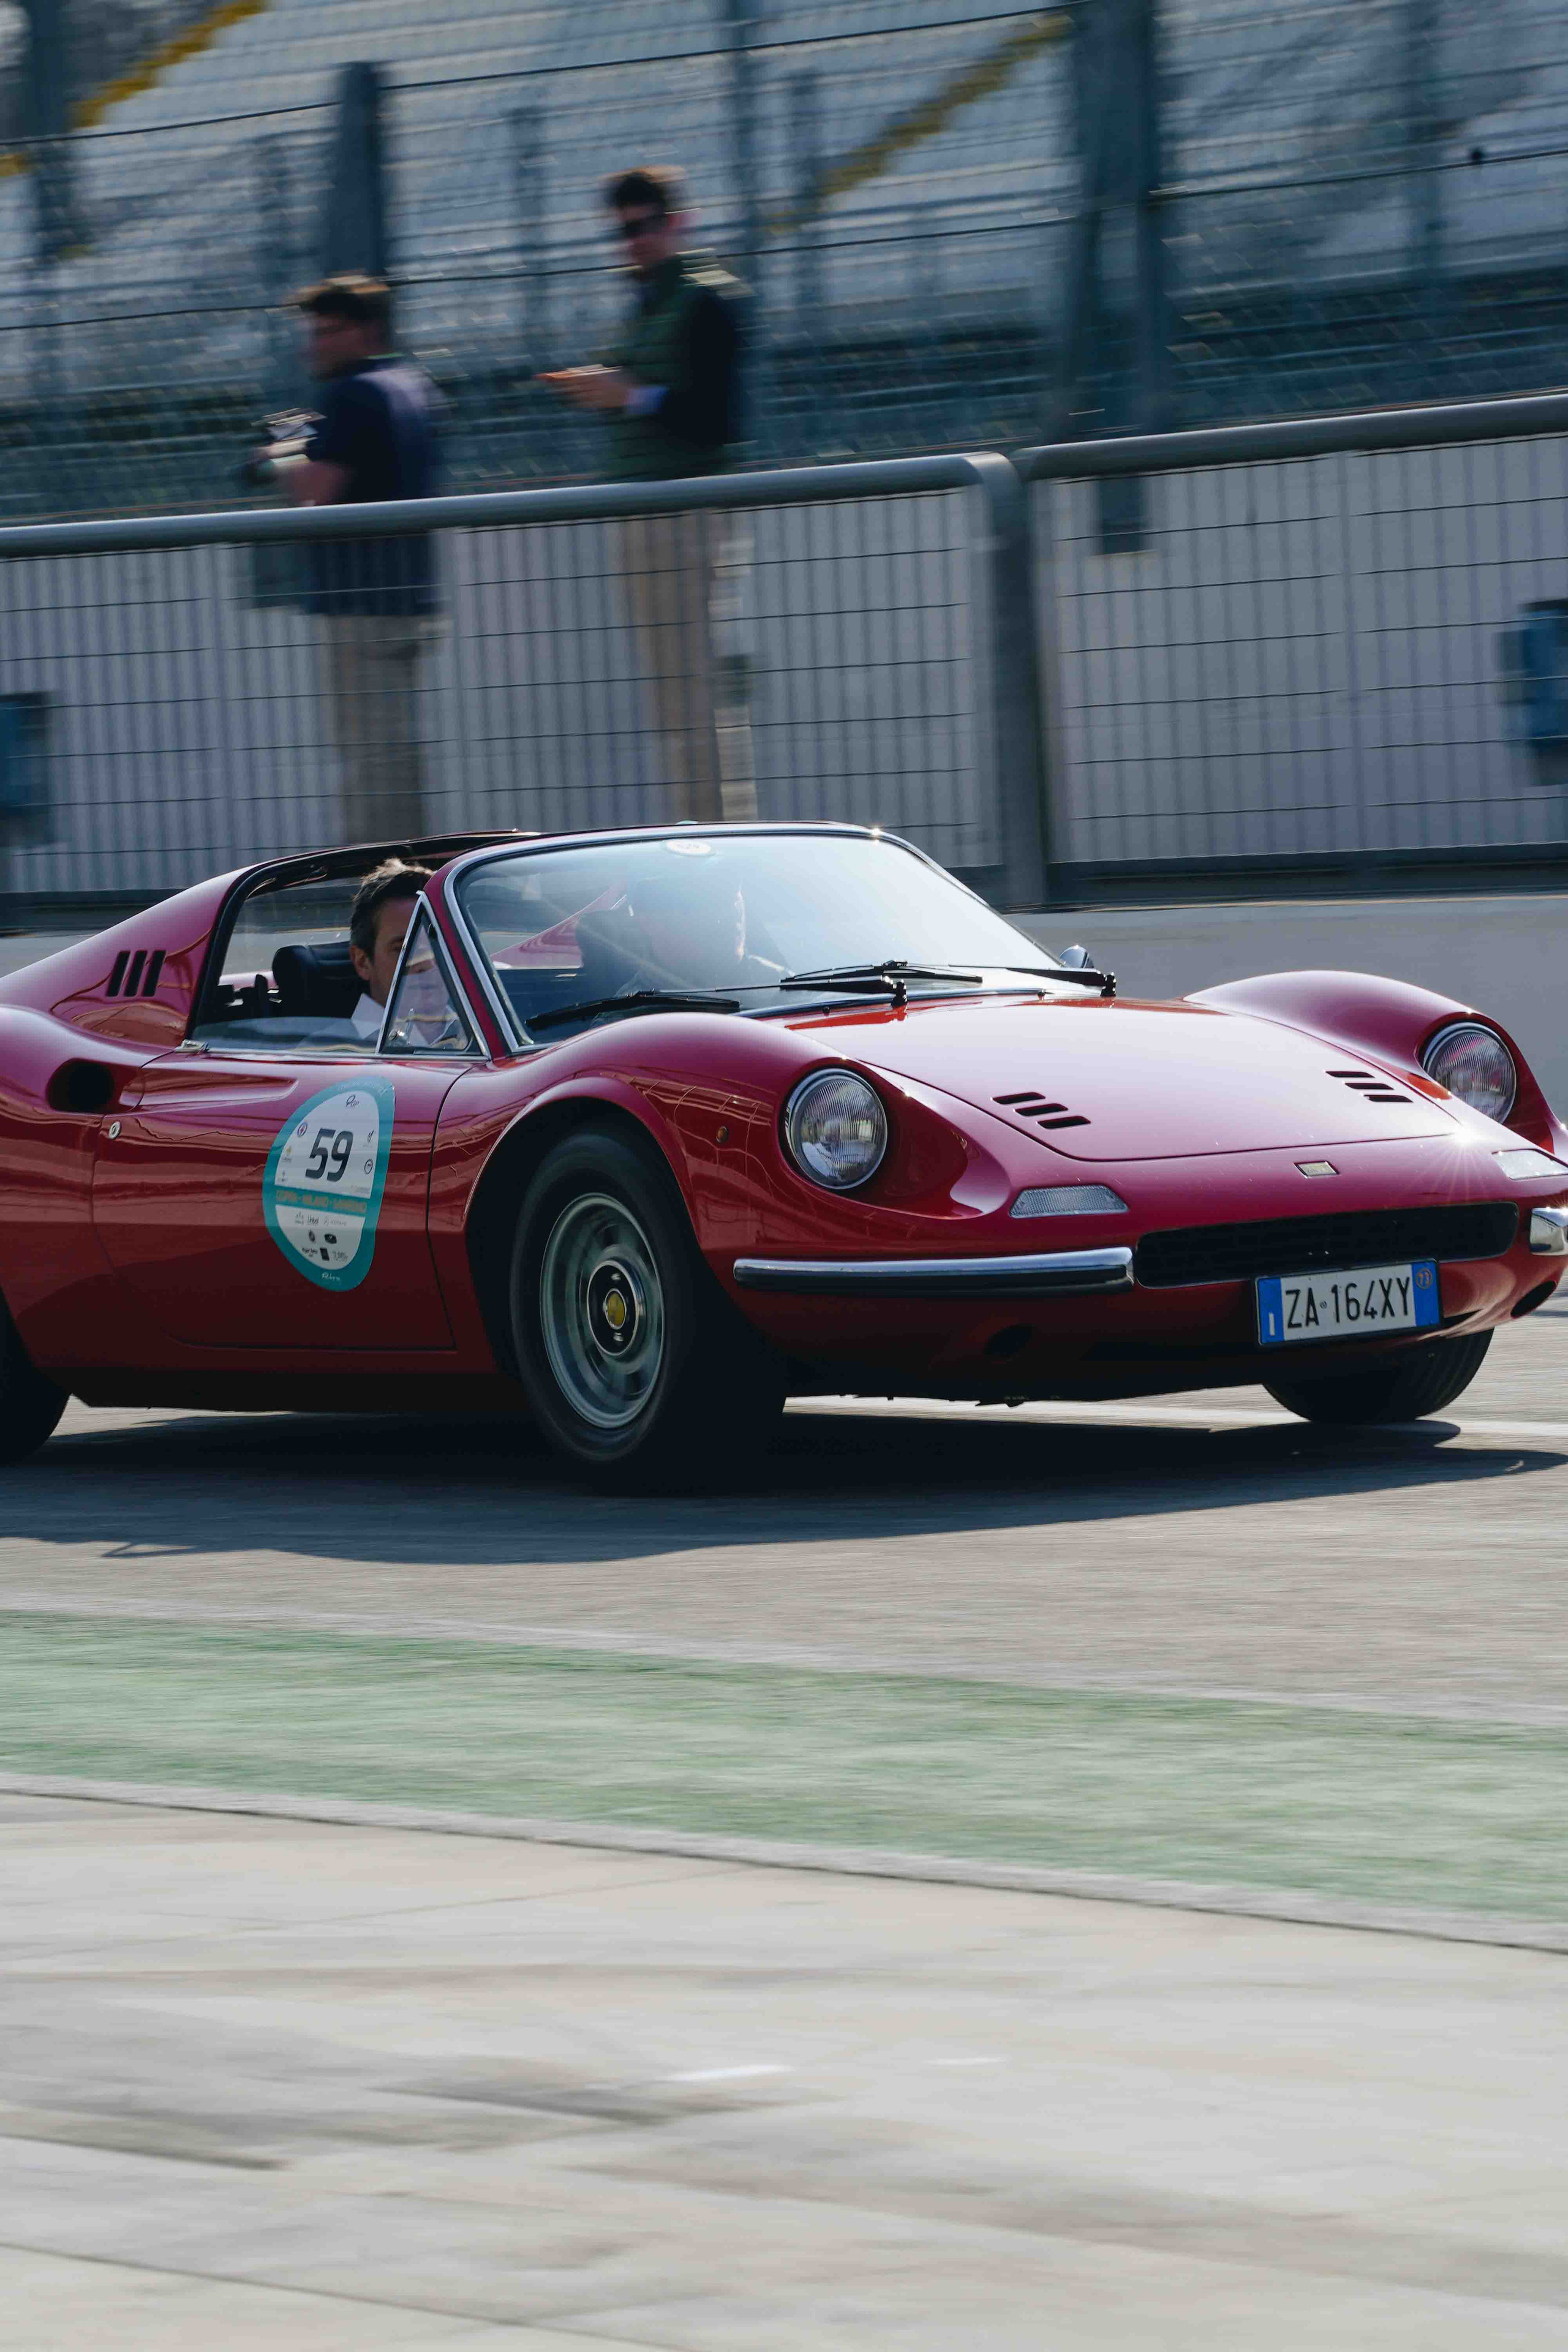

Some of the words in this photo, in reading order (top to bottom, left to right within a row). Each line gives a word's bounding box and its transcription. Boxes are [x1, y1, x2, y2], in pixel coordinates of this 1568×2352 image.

[305, 1128, 353, 1182] 59
[1285, 1287, 1320, 1329] ZA
[1331, 1276, 1410, 1324] 164XY
